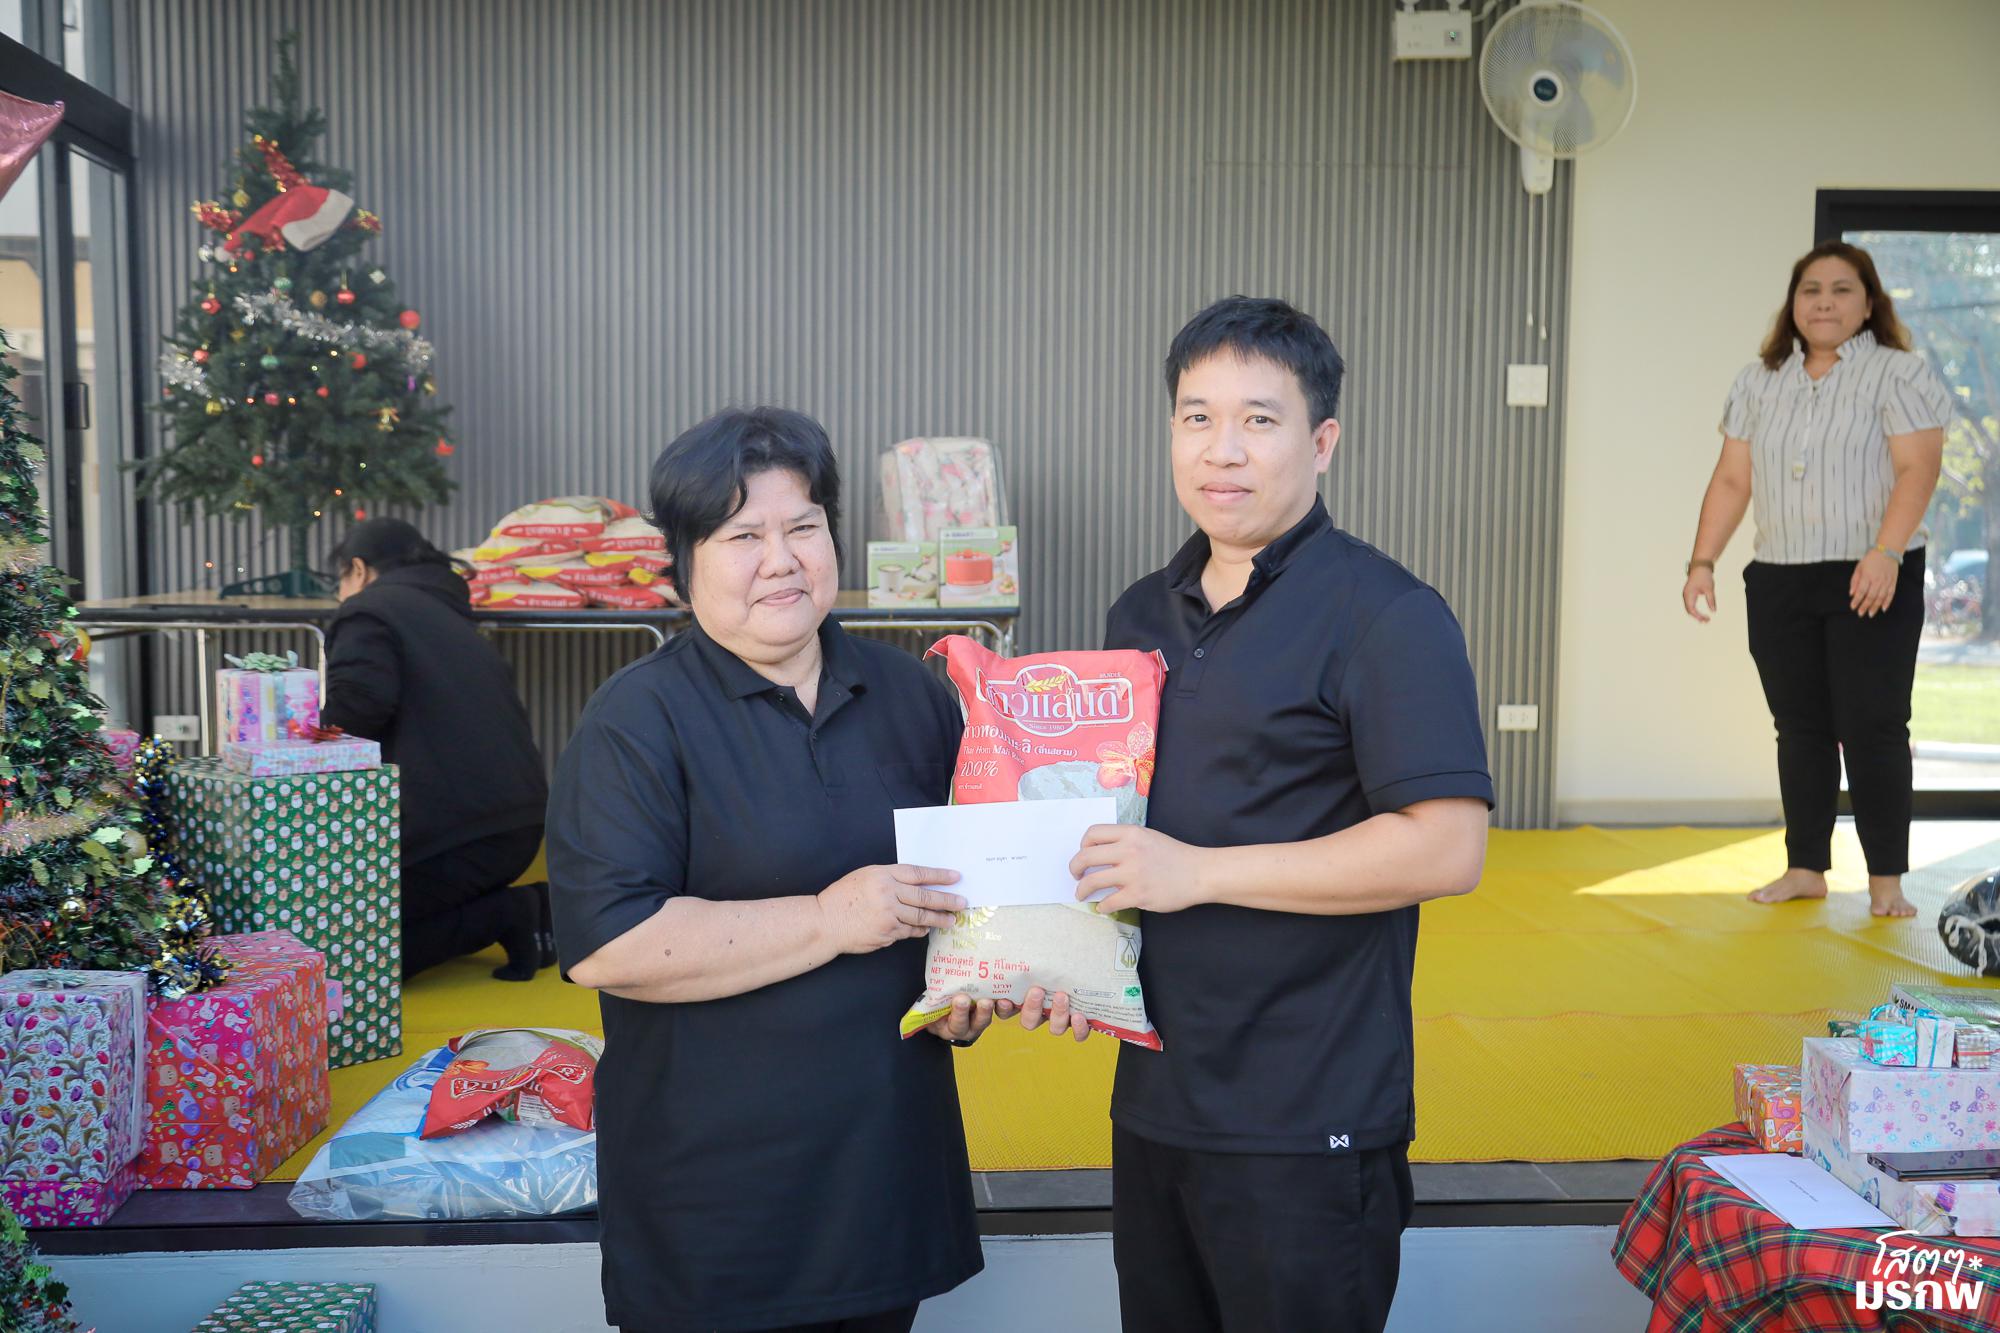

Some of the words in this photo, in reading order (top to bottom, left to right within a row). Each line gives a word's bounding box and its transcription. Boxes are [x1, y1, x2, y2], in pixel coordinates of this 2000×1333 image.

[960, 760, 999, 777] 100%
[930, 966, 942, 975] NET
[944, 967, 972, 978] WEIGHT
[932, 950, 974, 969] น้ำหนักสุทธิ
[978, 961, 989, 979] 5
[993, 973, 1005, 981] KG
[1900, 998, 1918, 1013] SMA
